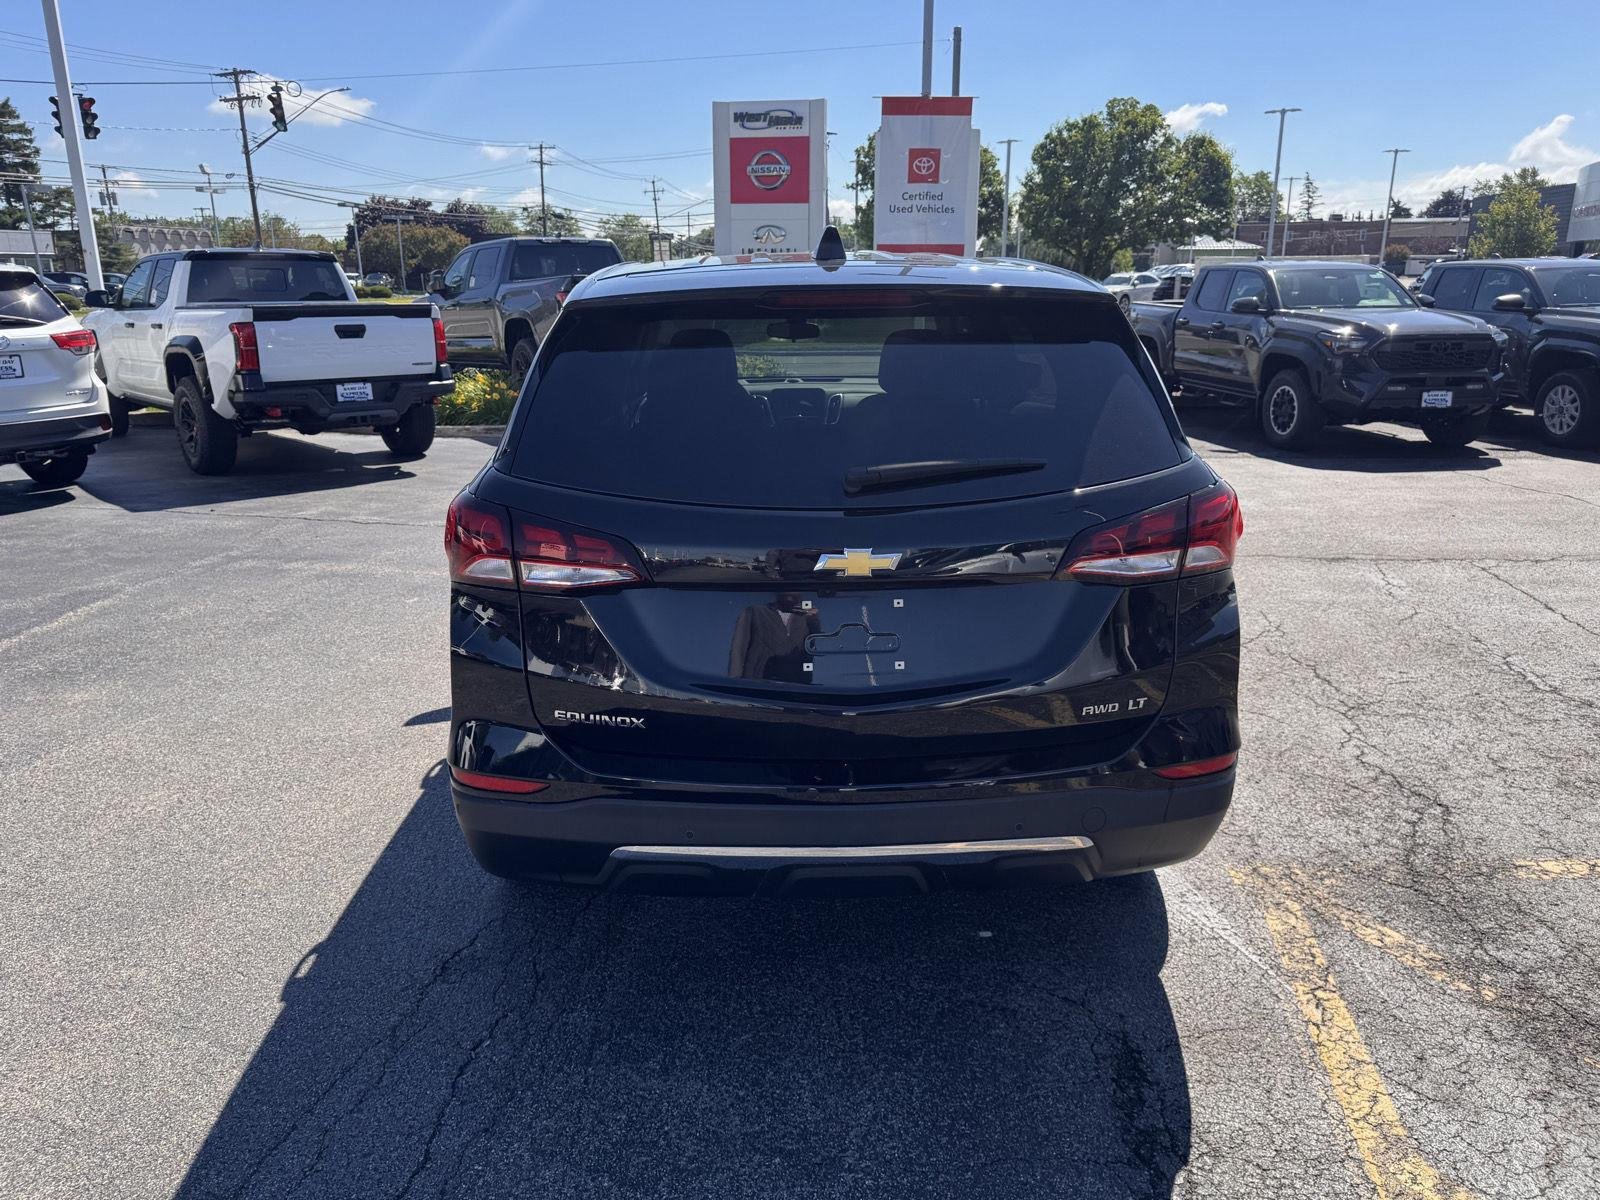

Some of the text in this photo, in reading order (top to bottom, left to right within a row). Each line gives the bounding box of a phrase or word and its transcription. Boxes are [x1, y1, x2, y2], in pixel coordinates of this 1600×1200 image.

[750, 166, 786, 174] NISSAN
[901, 191, 944, 201] Certified
[889, 203, 956, 214] Used Vehicles
[1082, 697, 1148, 715] AWD LT
[554, 710, 646, 728] EQUINOX
